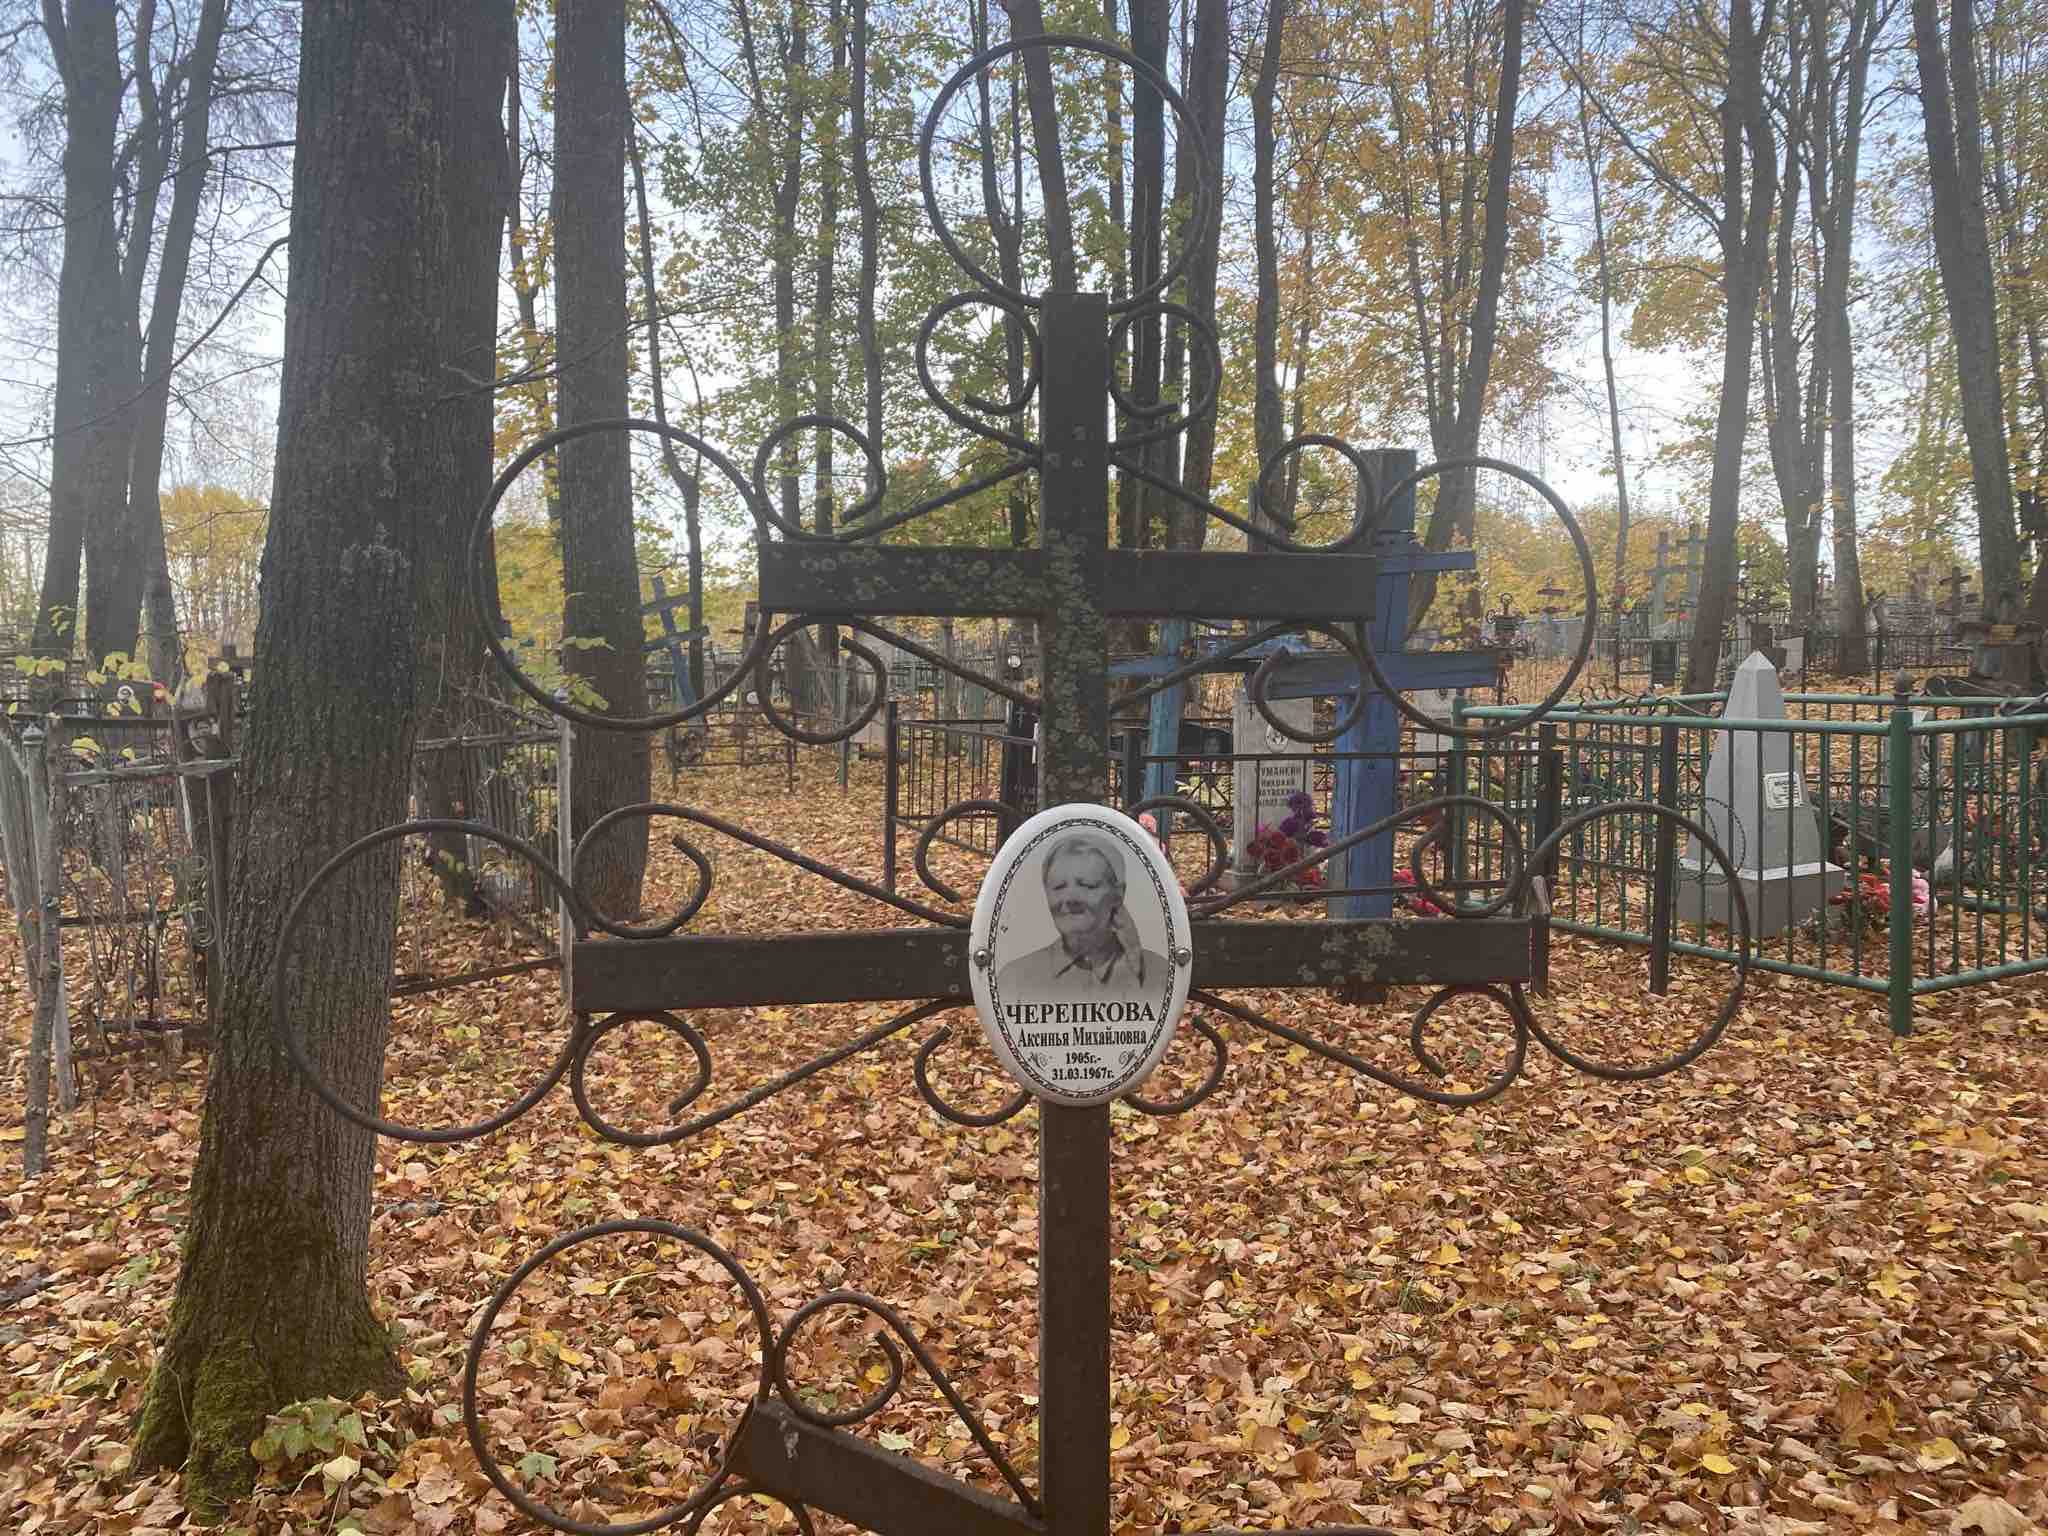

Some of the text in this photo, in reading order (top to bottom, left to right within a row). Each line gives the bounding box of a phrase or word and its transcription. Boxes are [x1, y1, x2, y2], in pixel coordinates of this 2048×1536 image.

[1006, 1002, 1156, 1025] ЧЕРЕПКОВА
[1017, 1026, 1147, 1048] Аксинья Михайловна
[1051, 1067, 1115, 1081] 31.03.1967г.
